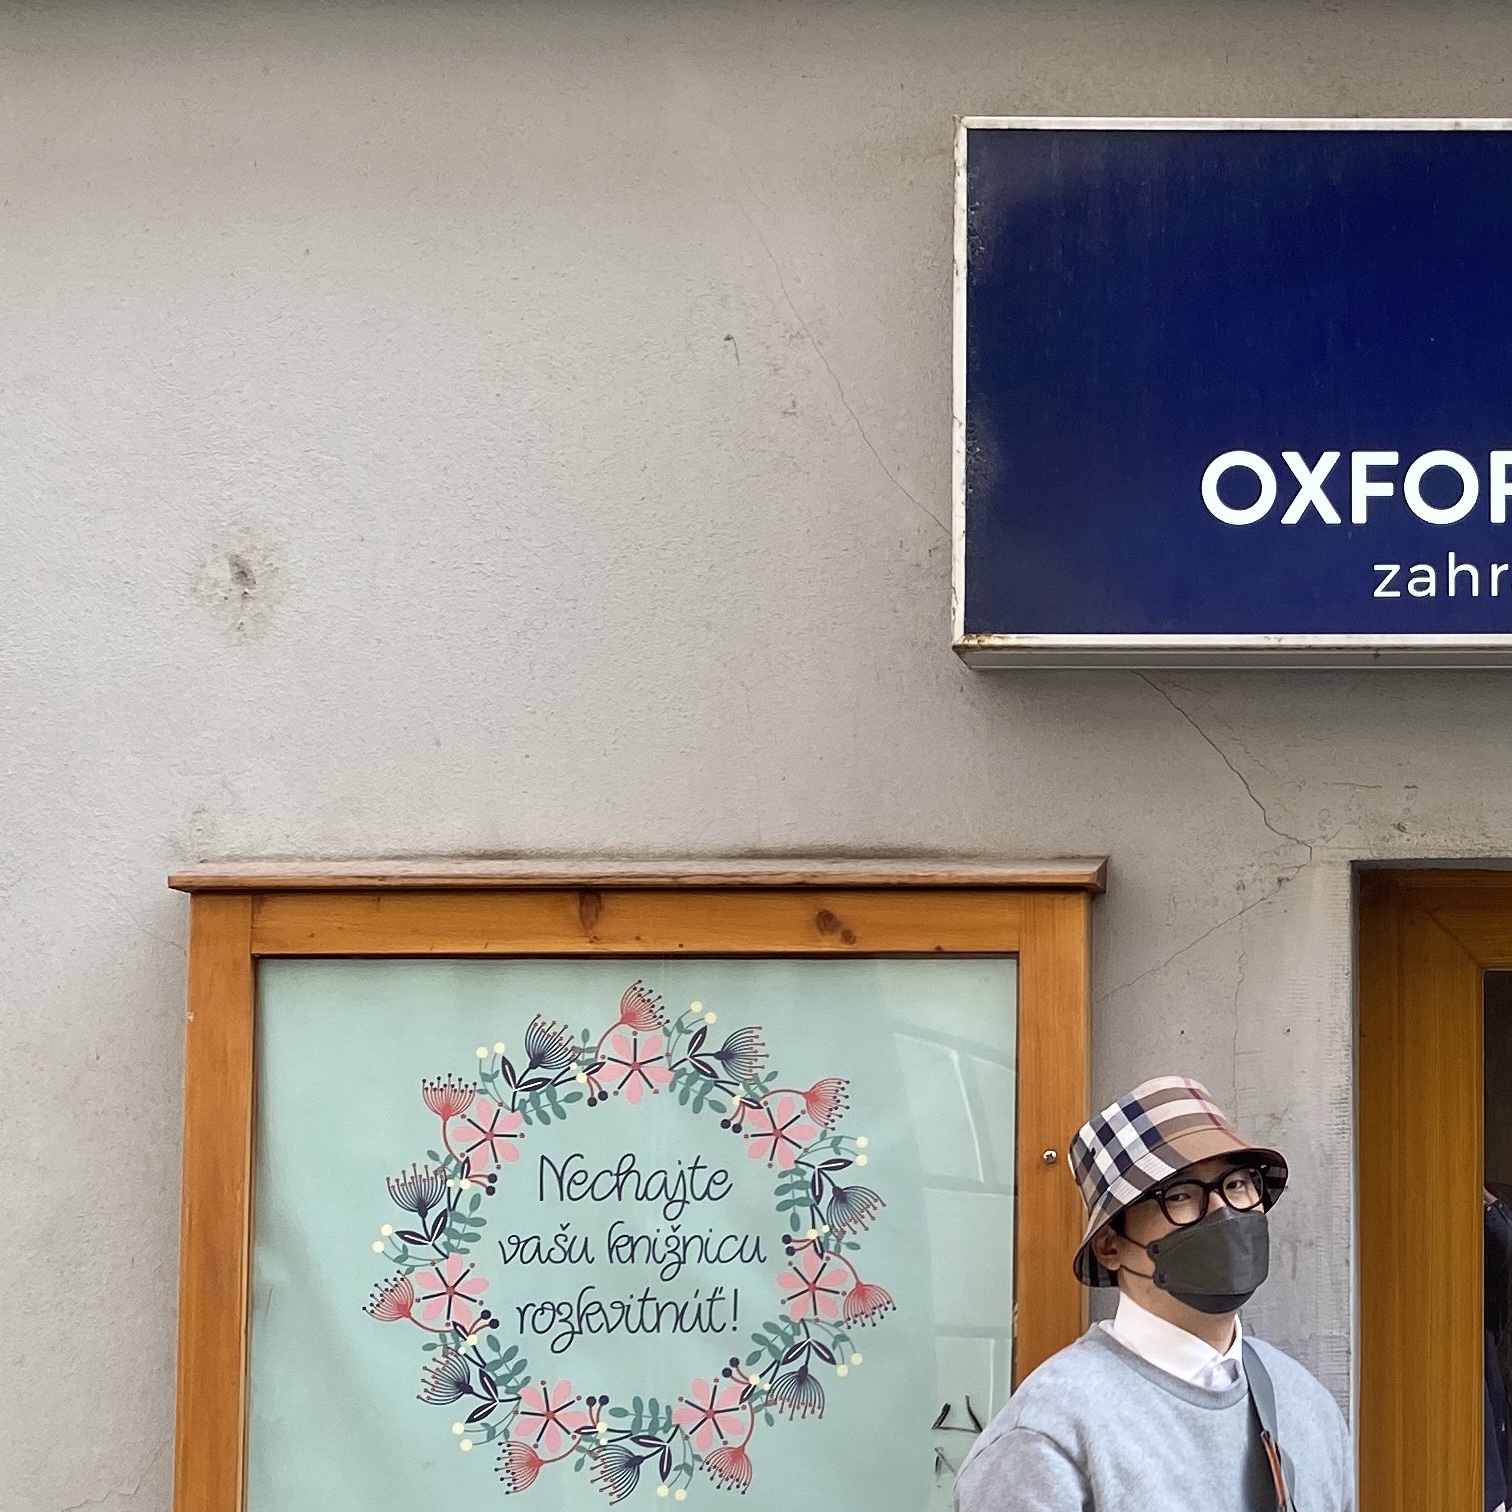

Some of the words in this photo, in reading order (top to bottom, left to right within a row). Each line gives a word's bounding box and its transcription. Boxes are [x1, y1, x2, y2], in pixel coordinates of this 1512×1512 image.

[539, 1153, 734, 1221] Nechajte
[498, 1222, 595, 1264] vašu
[607, 1220, 768, 1282] knižnicu
[516, 1286, 739, 1353] rozkvitnúť!
